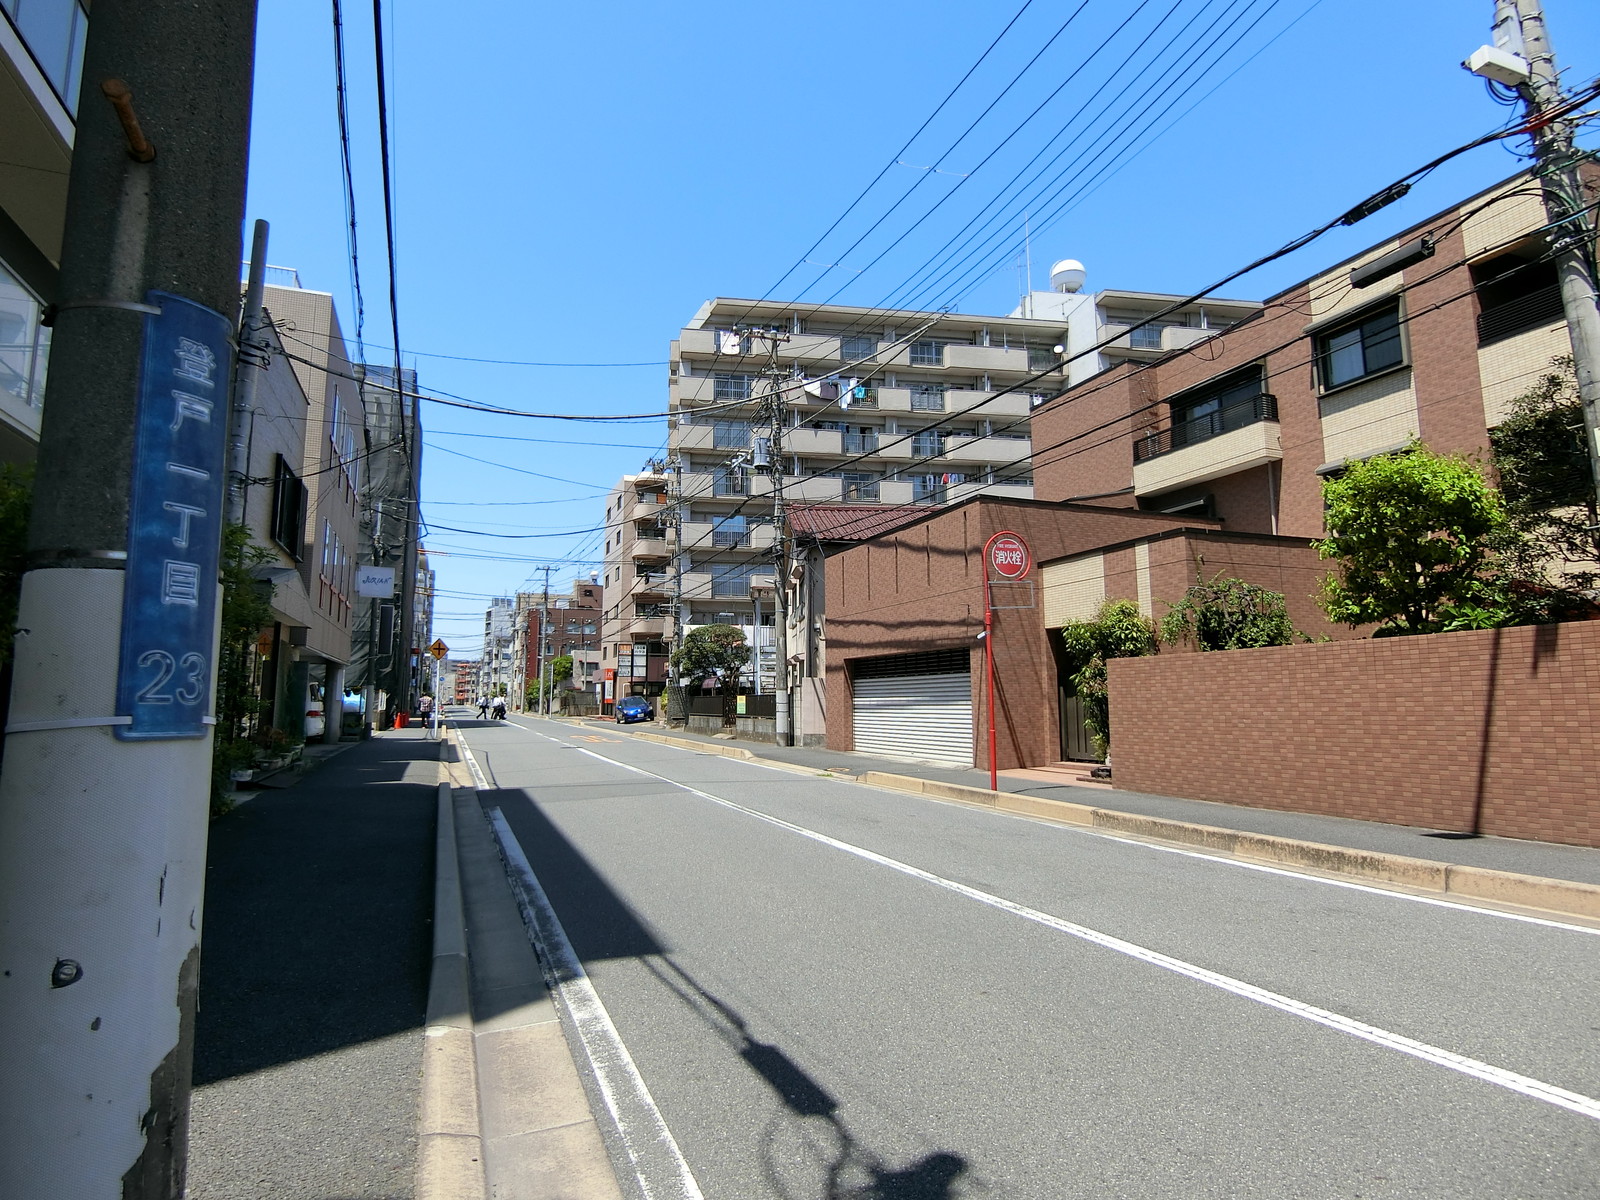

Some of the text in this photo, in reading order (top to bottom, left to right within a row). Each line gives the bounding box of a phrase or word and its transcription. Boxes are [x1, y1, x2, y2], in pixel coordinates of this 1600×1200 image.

[161, 336, 216, 606] 登戸一丁目
[995, 550, 1022, 565] 消火栓
[135, 648, 207, 707] 23
